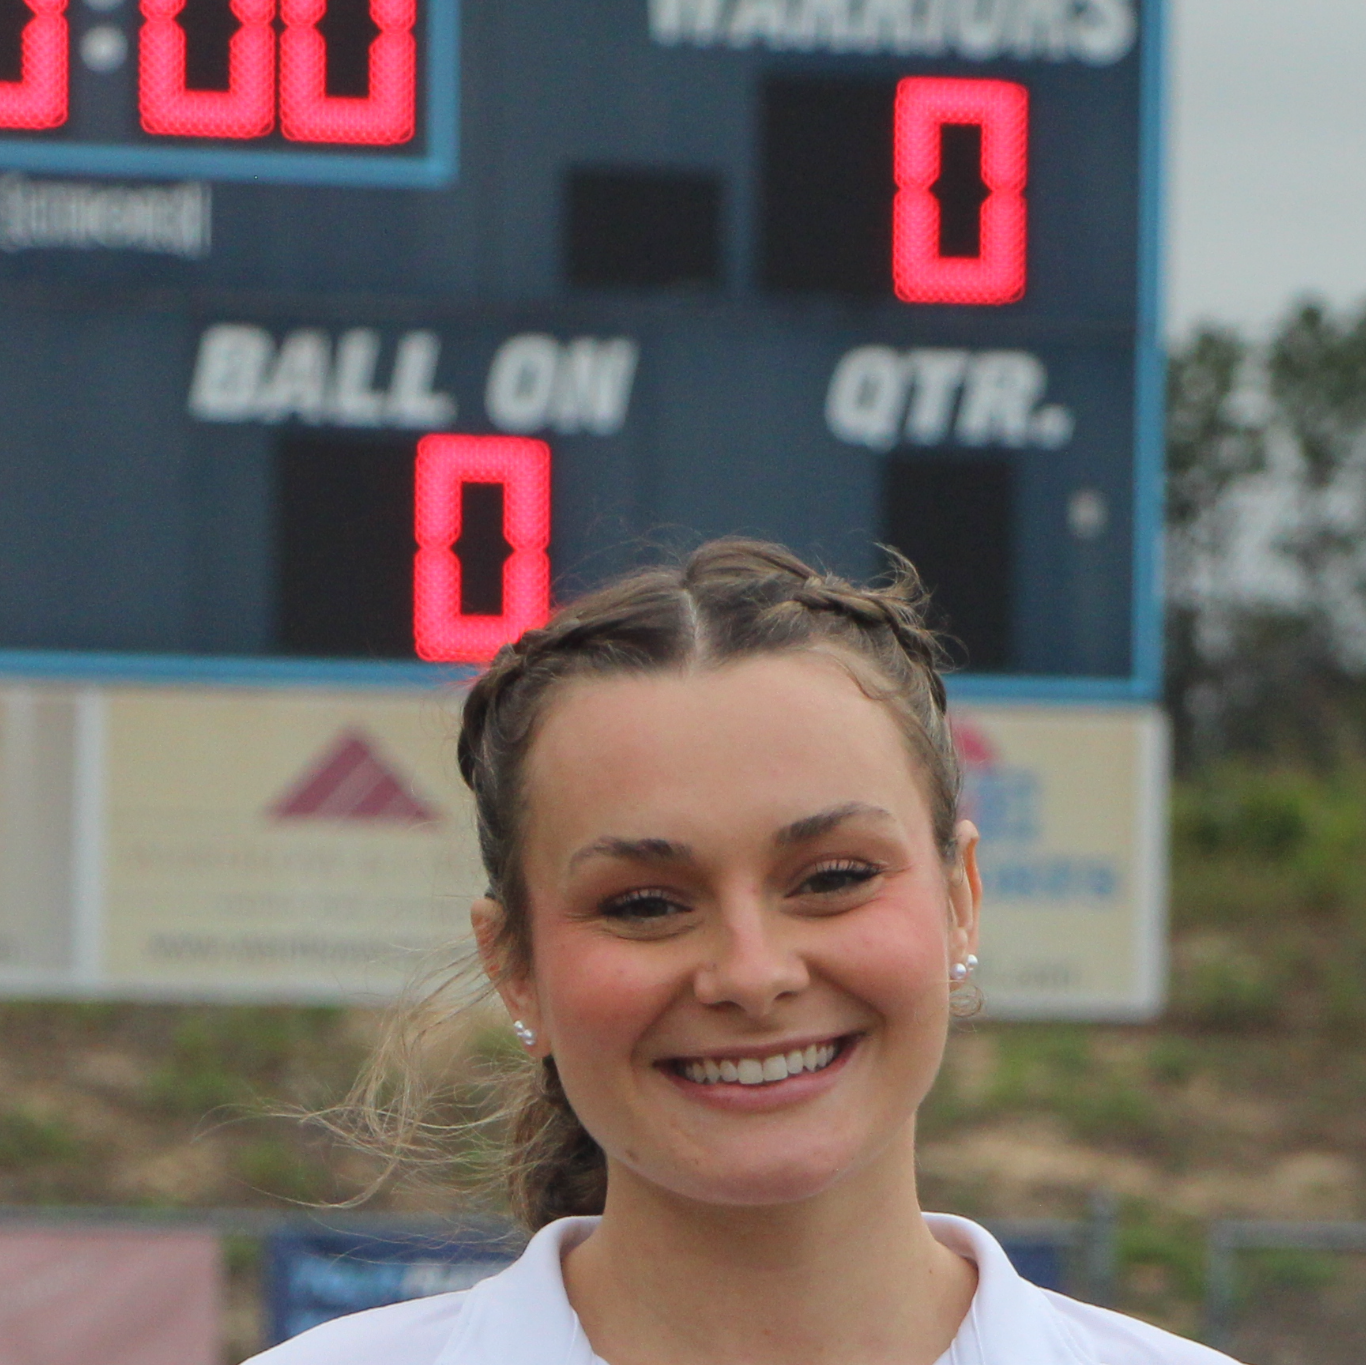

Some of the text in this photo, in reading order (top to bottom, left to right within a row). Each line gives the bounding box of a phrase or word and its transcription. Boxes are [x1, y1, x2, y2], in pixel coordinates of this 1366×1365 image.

[893, 77, 1027, 304] 0
[190, 324, 636, 433] BALL ON
[826, 346, 1073, 448] QTR.
[414, 434, 551, 664] 0
